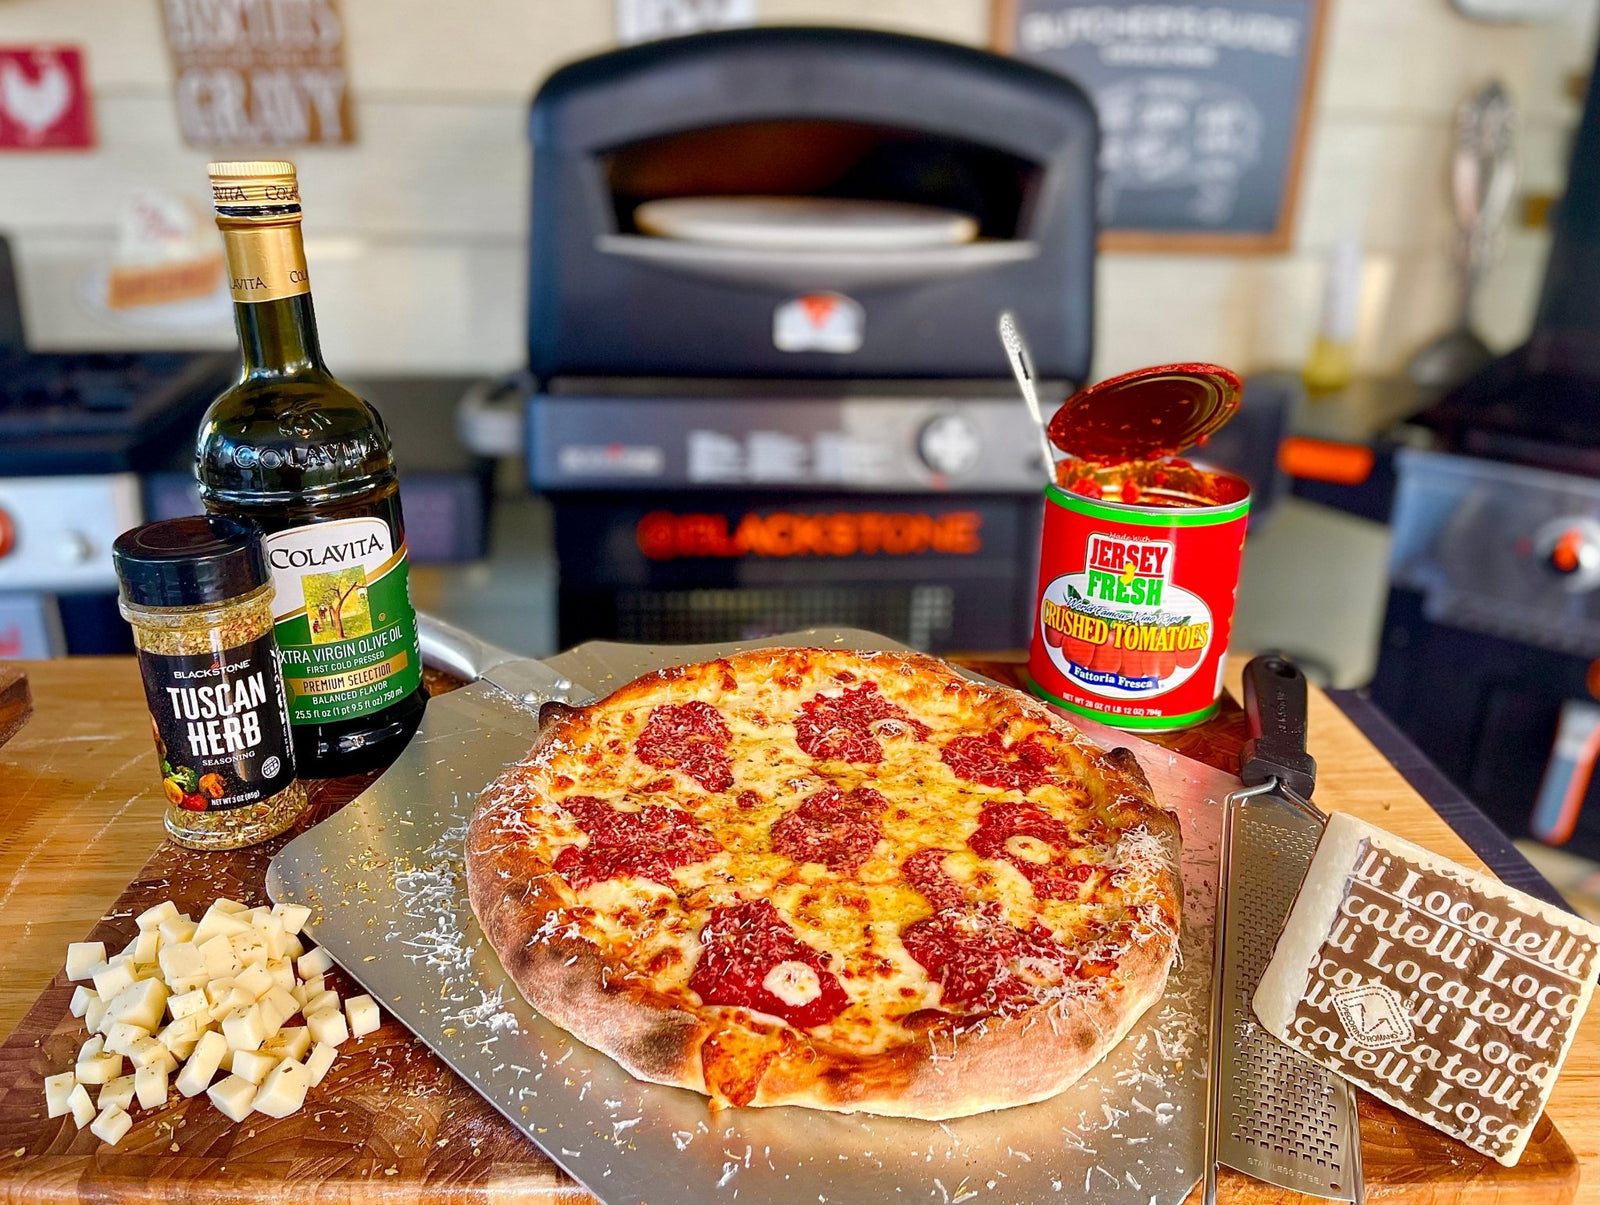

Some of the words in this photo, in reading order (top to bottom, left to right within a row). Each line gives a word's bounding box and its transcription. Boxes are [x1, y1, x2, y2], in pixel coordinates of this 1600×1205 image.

[269, 533, 383, 570] COLAVITA
[1089, 538, 1169, 574] JERSEY
[1086, 569, 1164, 606] FRESH
[1042, 598, 1110, 646] CRUSHED
[1112, 621, 1210, 653] TOMATOES
[278, 649, 311, 664] XTRA
[312, 642, 356, 662] VIRGIN
[358, 632, 389, 654] OLIVE
[390, 625, 403, 643] OIL
[306, 664, 329, 674] FIRST
[330, 661, 352, 672] COLD
[353, 650, 385, 665] PRESSED
[173, 660, 250, 679] BLACKSTONE
[303, 677, 345, 693] PREMIUM
[347, 662, 391, 687] SELECTION
[1074, 665, 1116, 684] Fattoria
[1117, 676, 1153, 689] Fresca
[166, 671, 267, 720] TUSCAN
[295, 710, 312, 720] 25.5
[313, 709, 321, 718] fl
[321, 710, 331, 718] oz
[332, 707, 340, 717] (1
[341, 706, 351, 716] pt
[351, 701, 363, 712] 9.5
[364, 700, 371, 709] fl
[371, 695, 383, 706] oz)
[383, 690, 395, 702] 750
[312, 690, 358, 706] BALANCED
[359, 680, 388, 697] FLAVOR
[186, 710, 262, 757] HERB
[202, 750, 256, 766] SEASONING
[211, 798, 222, 806] NET
[236, 794, 245, 802] OZ
[1391, 867, 1593, 977] Locatelli
[1362, 936, 1560, 1050] Locatelli
[1341, 1005, 1367, 1042] PECORINO
[1366, 1033, 1399, 1044] ROMANO
